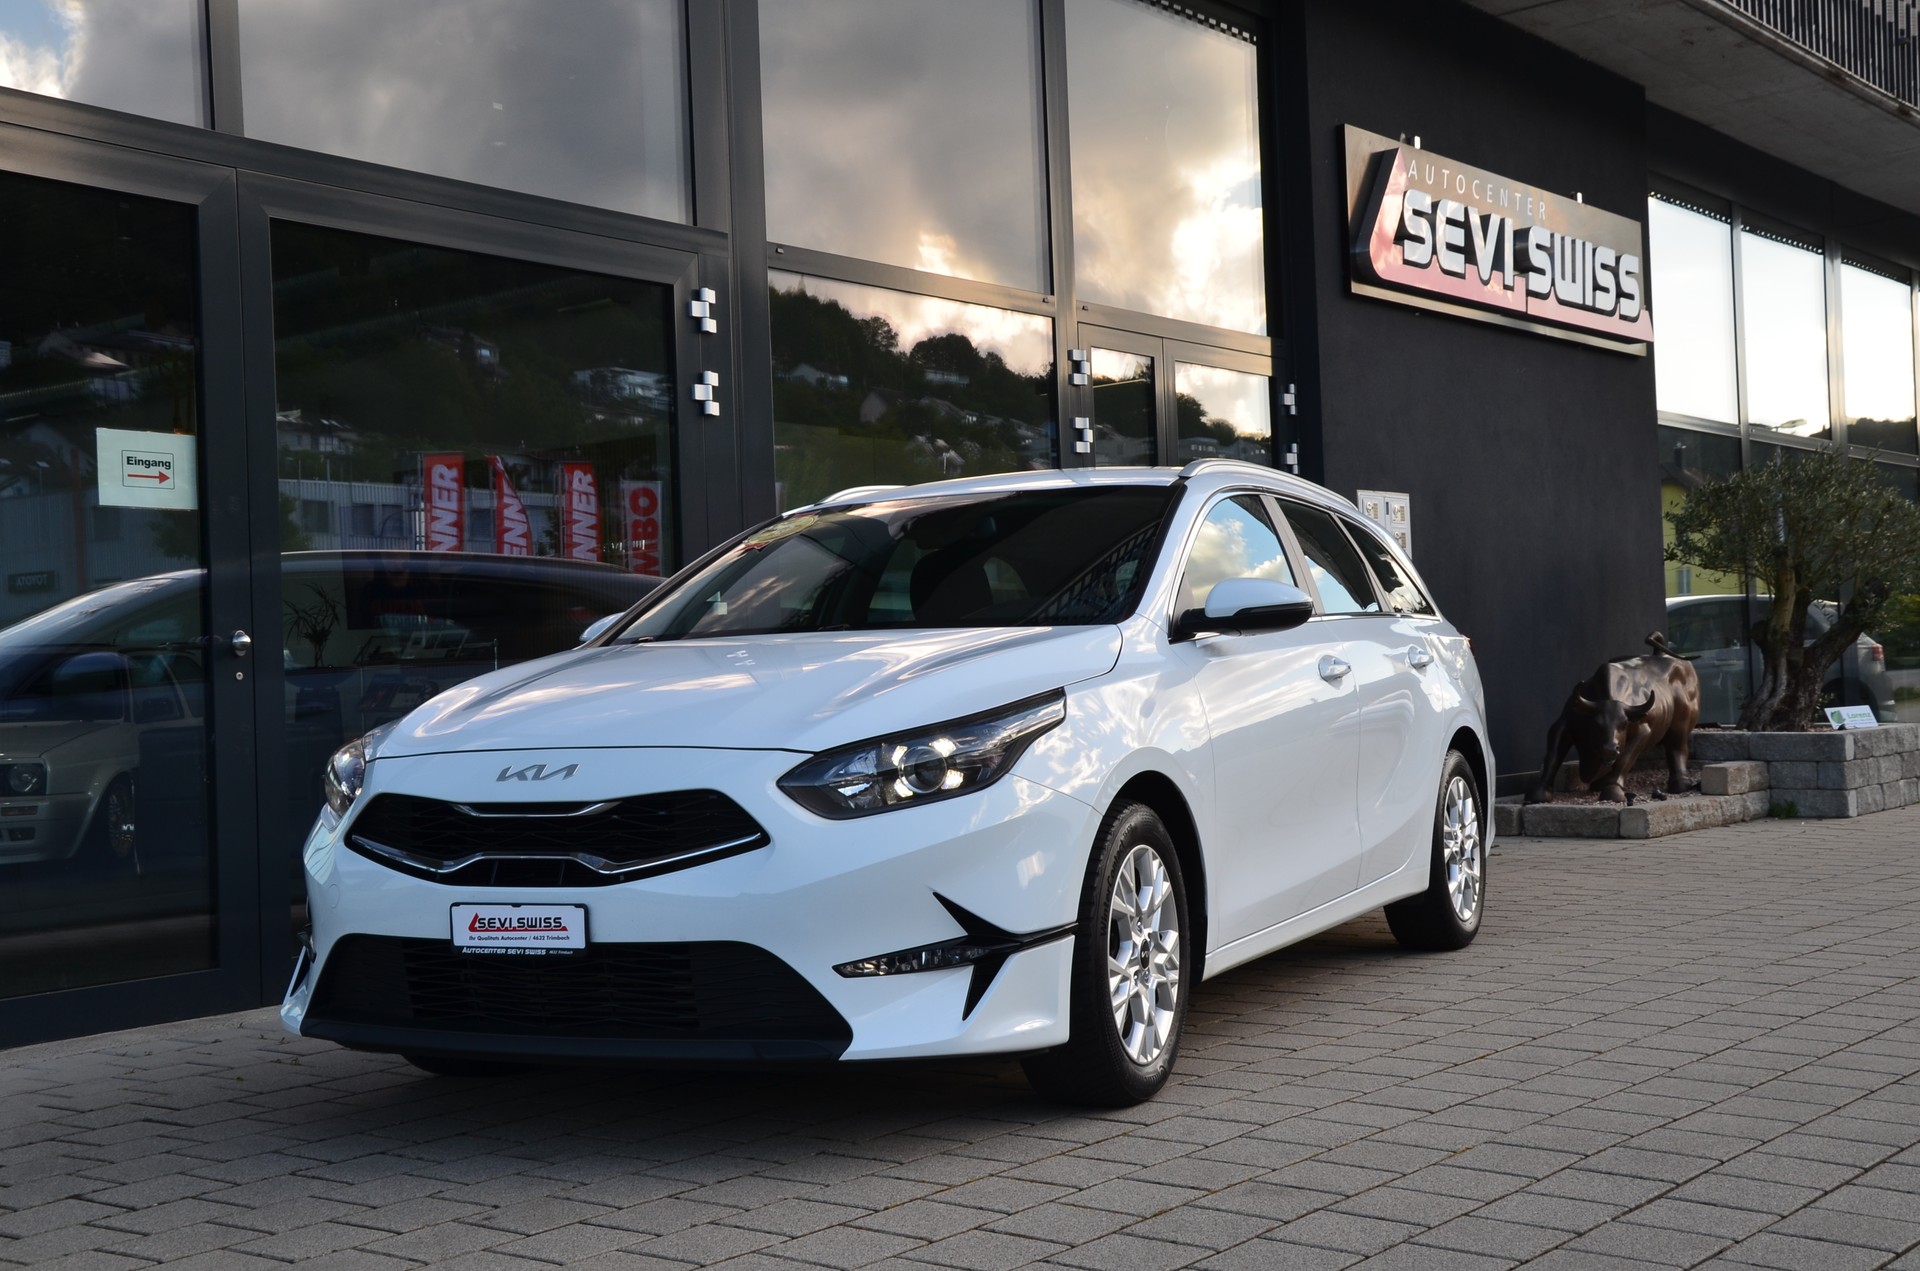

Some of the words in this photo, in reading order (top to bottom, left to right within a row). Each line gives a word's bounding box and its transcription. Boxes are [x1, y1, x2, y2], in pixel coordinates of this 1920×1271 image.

[1408, 159, 1546, 220] AUTOCENTER
[126, 456, 172, 470] Eingang
[496, 764, 580, 781] KIA
